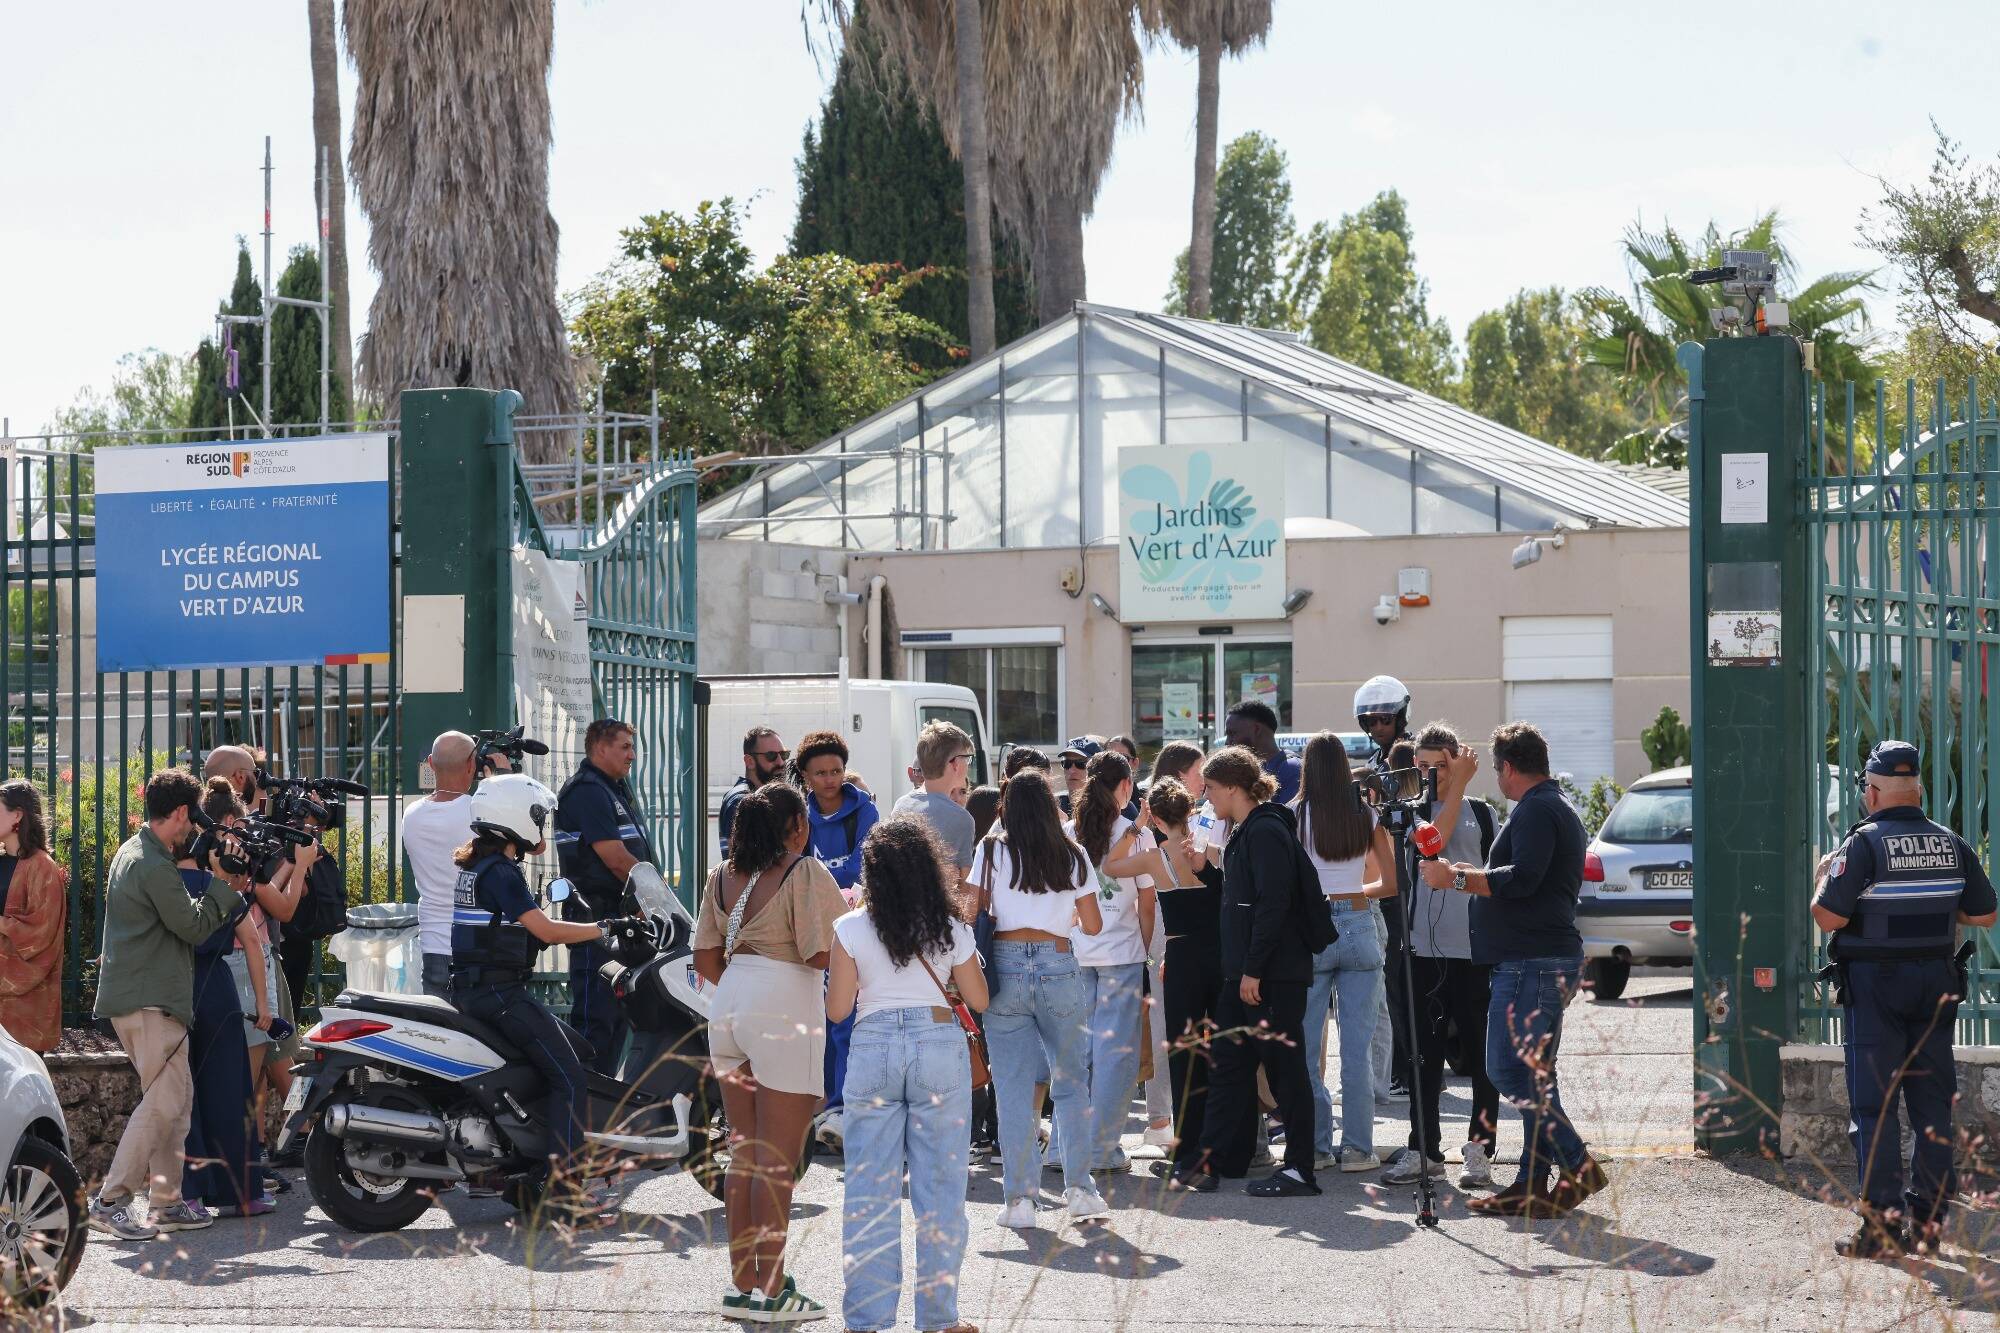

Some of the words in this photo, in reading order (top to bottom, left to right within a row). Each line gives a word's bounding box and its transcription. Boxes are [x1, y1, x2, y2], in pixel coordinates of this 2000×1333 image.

[254, 449, 289, 457] PROVENCE
[254, 458, 273, 466] ALPES
[206, 465, 230, 476] SUD
[150, 499, 193, 513] LIBERTÉ
[210, 496, 256, 511] ÉGALITÉ
[272, 492, 338, 508] FRATERNITÉ
[1150, 500, 1243, 536] Jardins
[161, 542, 218, 566] LYCÉE
[223, 541, 322, 564] RÉGIONAL
[1128, 535, 1182, 561] Vert
[1192, 533, 1277, 560] d'Azur
[184, 573, 212, 591] DU
[216, 569, 299, 590] CAMPUS
[1142, 585, 1190, 593] Producteur
[180, 599, 228, 617] VERT
[233, 595, 305, 615] D'AZUR
[1886, 836, 1953, 855] POLICE
[1891, 855, 1955, 869] MUNICIPALE
